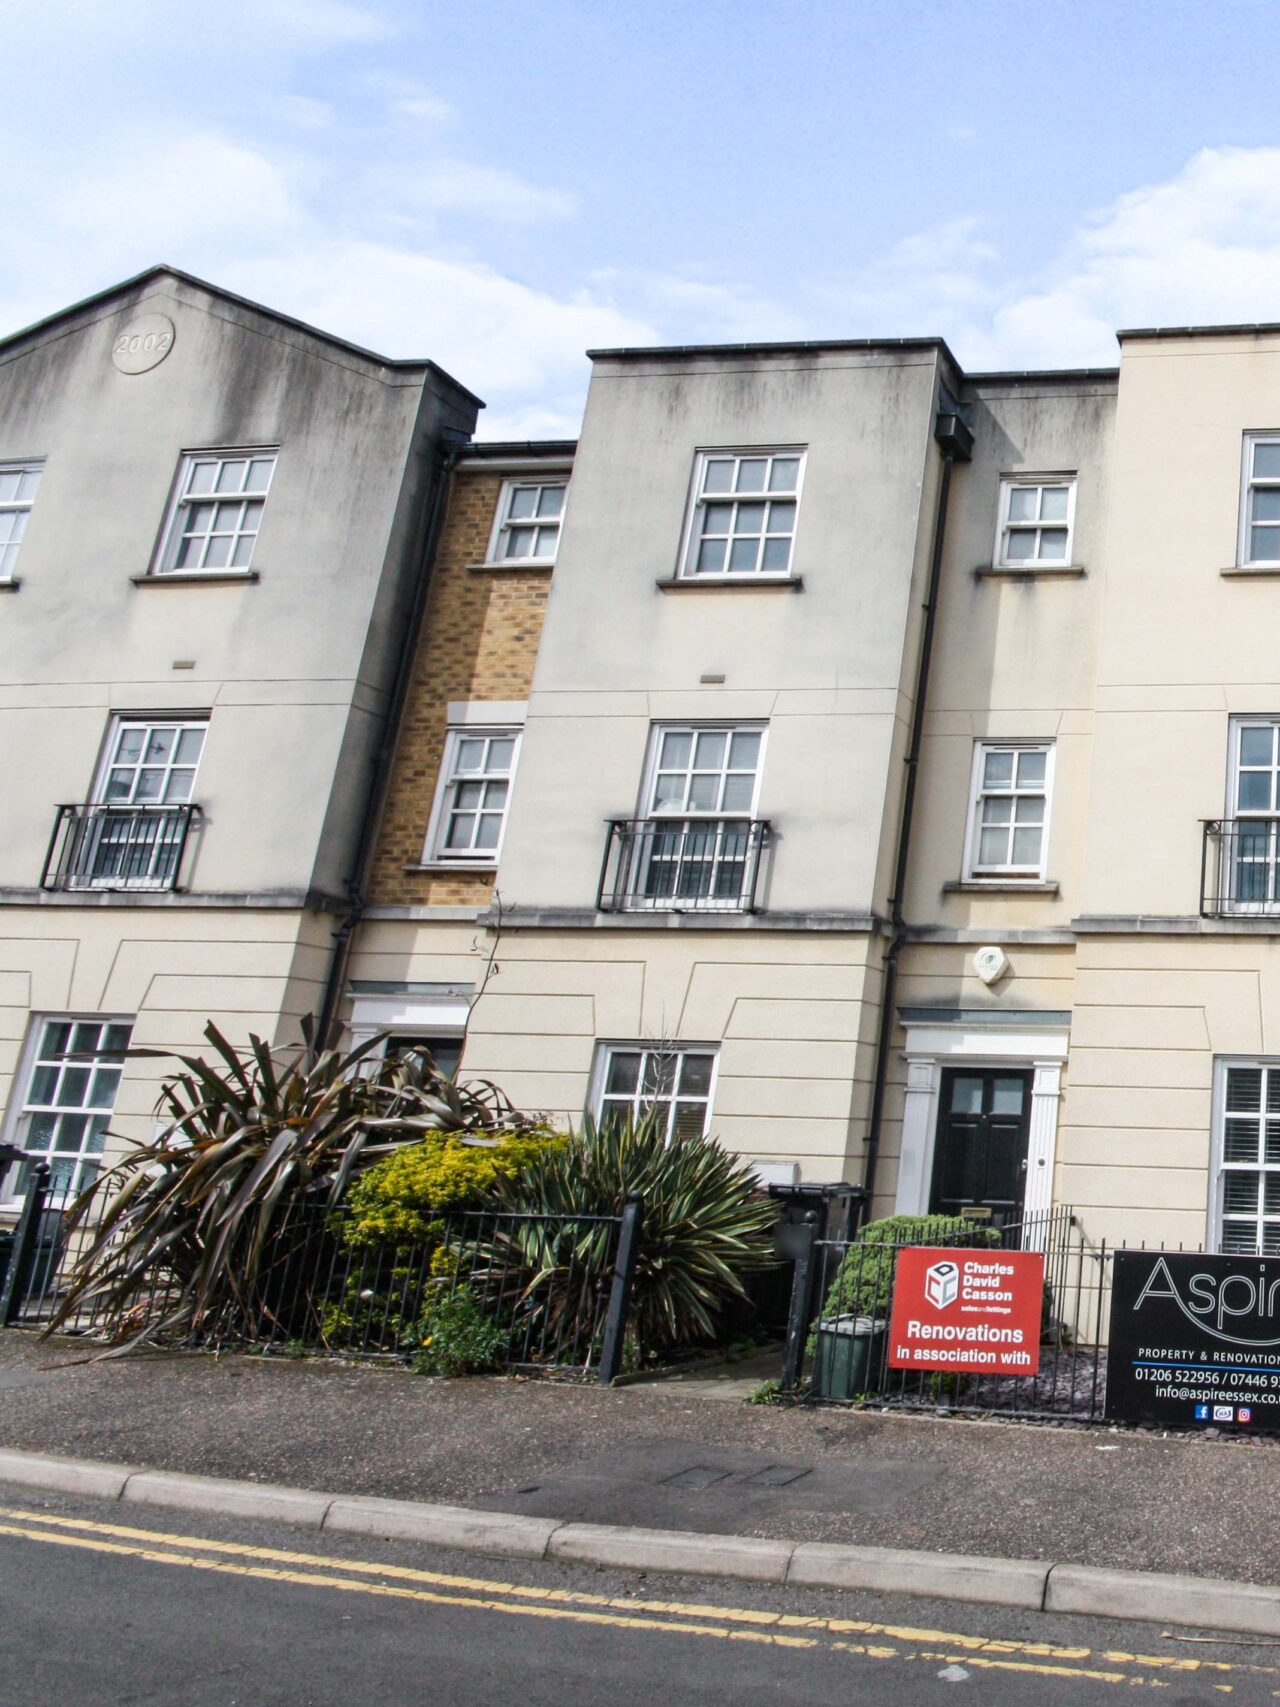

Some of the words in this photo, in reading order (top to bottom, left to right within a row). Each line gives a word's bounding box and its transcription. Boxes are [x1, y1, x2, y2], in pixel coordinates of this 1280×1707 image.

[114, 332, 171, 354] 2002
[963, 1261, 1014, 1275] Charles
[962, 1275, 1000, 1288] David
[961, 1287, 1013, 1301] Casson
[907, 1320, 1024, 1343] Renovations
[896, 1345, 910, 1359] in
[913, 1348, 996, 1363] association
[1000, 1350, 1031, 1365] with
[1138, 1348, 1195, 1361] PROPERTY
[1200, 1351, 1208, 1361] &
[1135, 1367, 1172, 1382] 01206
[1174, 1370, 1220, 1385] 522956
[1221, 1372, 1229, 1385] /
[1230, 1373, 1268, 1387] 07446
